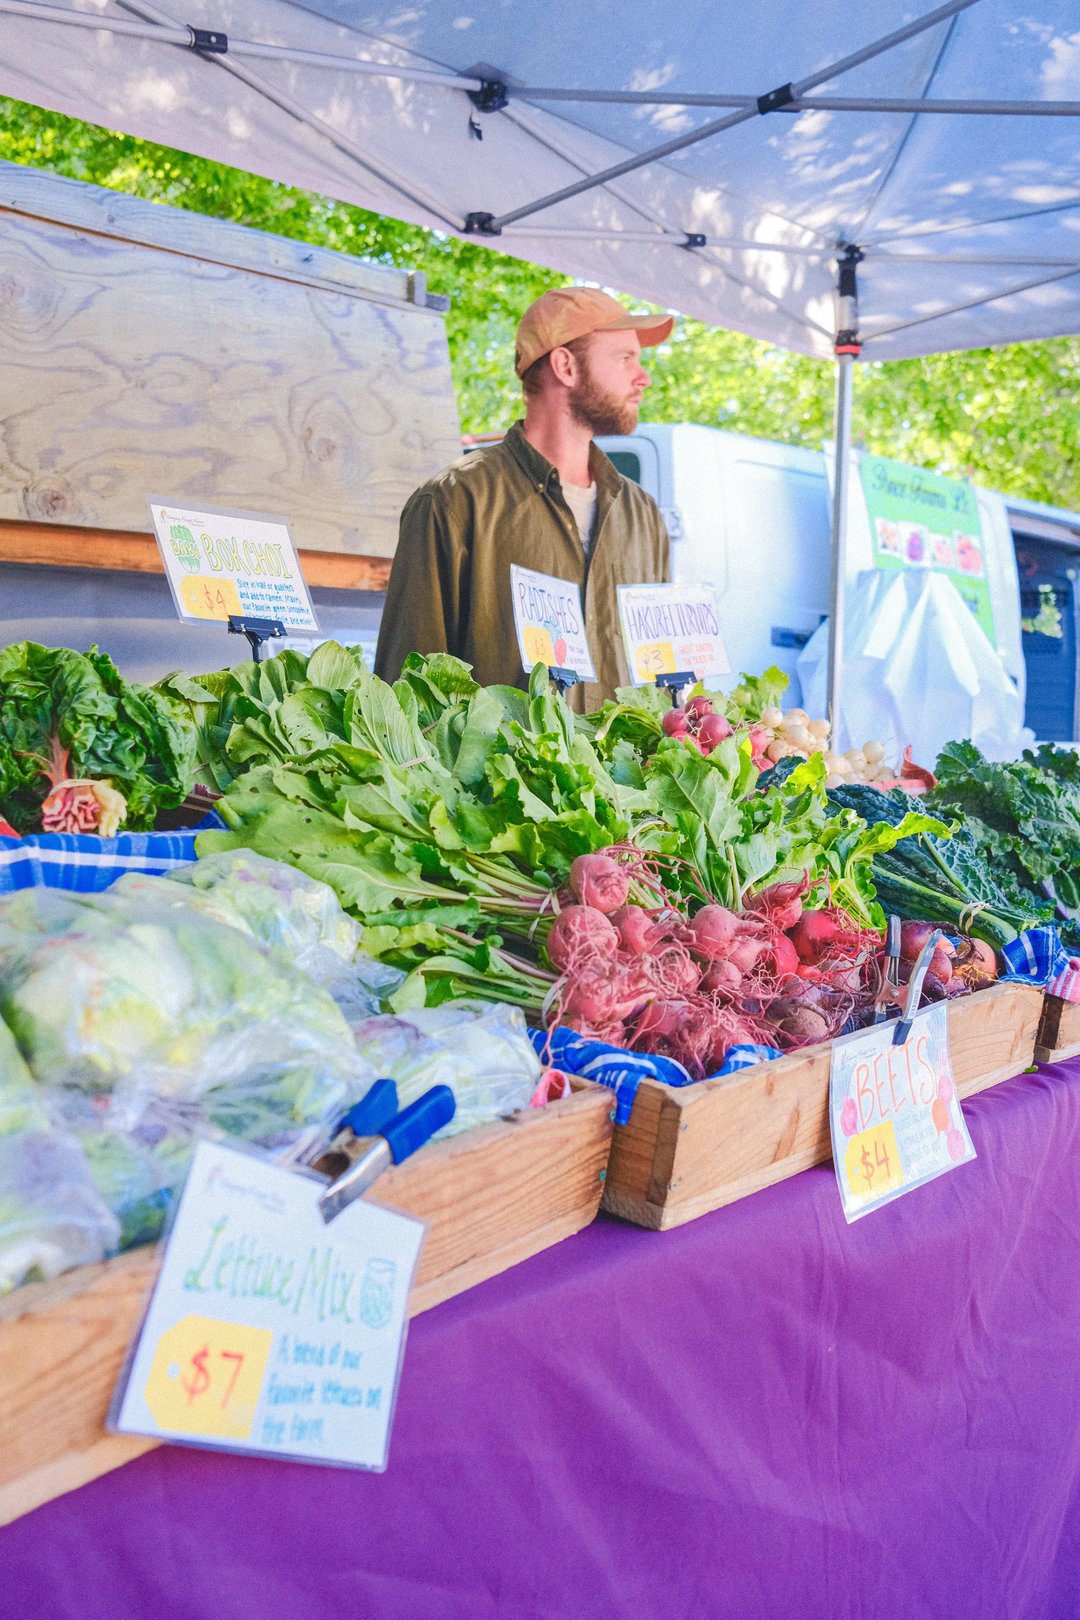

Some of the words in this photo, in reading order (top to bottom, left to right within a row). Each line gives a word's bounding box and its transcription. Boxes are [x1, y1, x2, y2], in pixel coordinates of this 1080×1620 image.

[200, 533, 251, 577] BOK
[242, 539, 294, 579] CHOI
[203, 583, 229, 616] $4
[518, 582, 580, 636] RADISHES
[856, 1036, 936, 1129] BEETS
[861, 1140, 890, 1190] $4
[182, 1342, 245, 1409] $7
